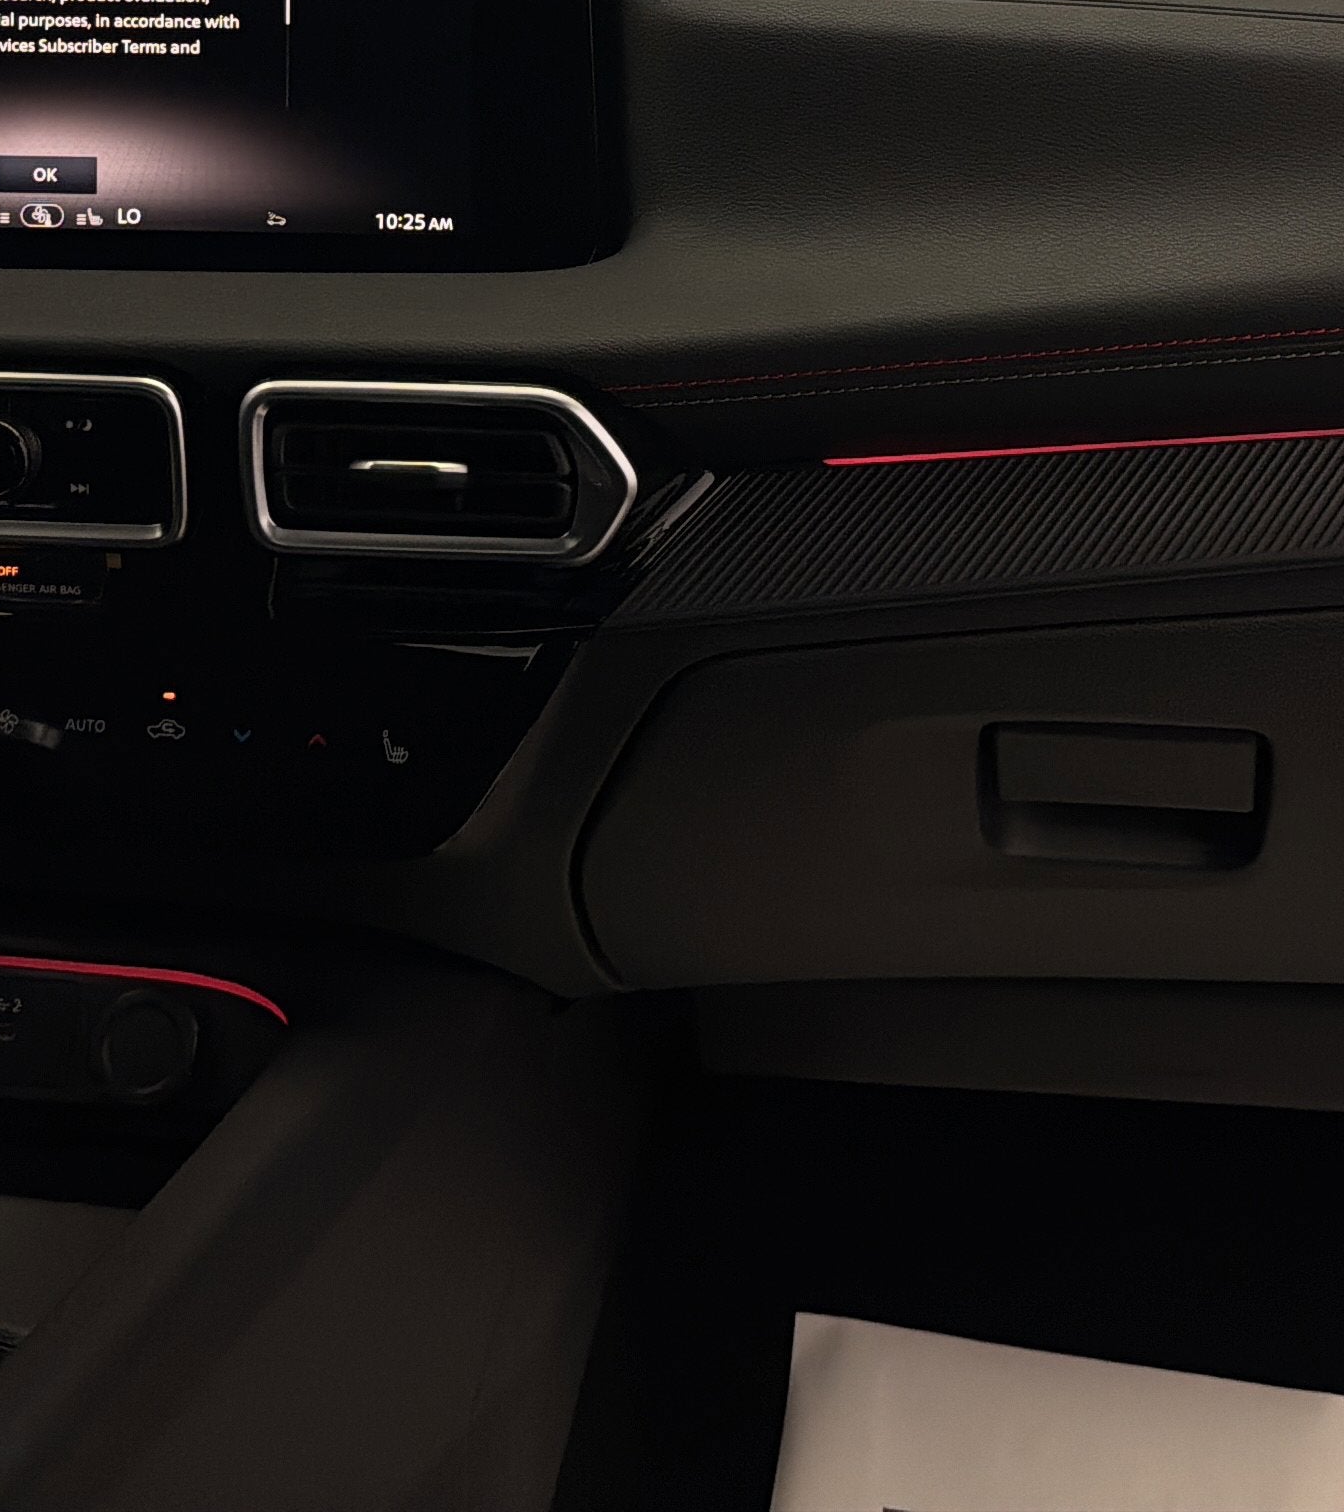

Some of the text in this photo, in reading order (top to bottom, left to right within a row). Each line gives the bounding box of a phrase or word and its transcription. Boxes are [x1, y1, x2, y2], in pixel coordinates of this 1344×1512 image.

[17, 14, 92, 32] purposes,
[94, 12, 111, 29] in
[112, 12, 202, 30] accordance
[203, 12, 240, 30] with
[37, 36, 119, 55] Subscriber
[120, 38, 168, 56] Terms
[168, 38, 201, 56] and
[32, 166, 58, 183] OK
[116, 206, 142, 225] LO
[374, 212, 454, 232] 10:25 AM
[39, 584, 57, 594] AIR
[60, 584, 82, 596] BAG
[65, 717, 106, 733] AUTO
